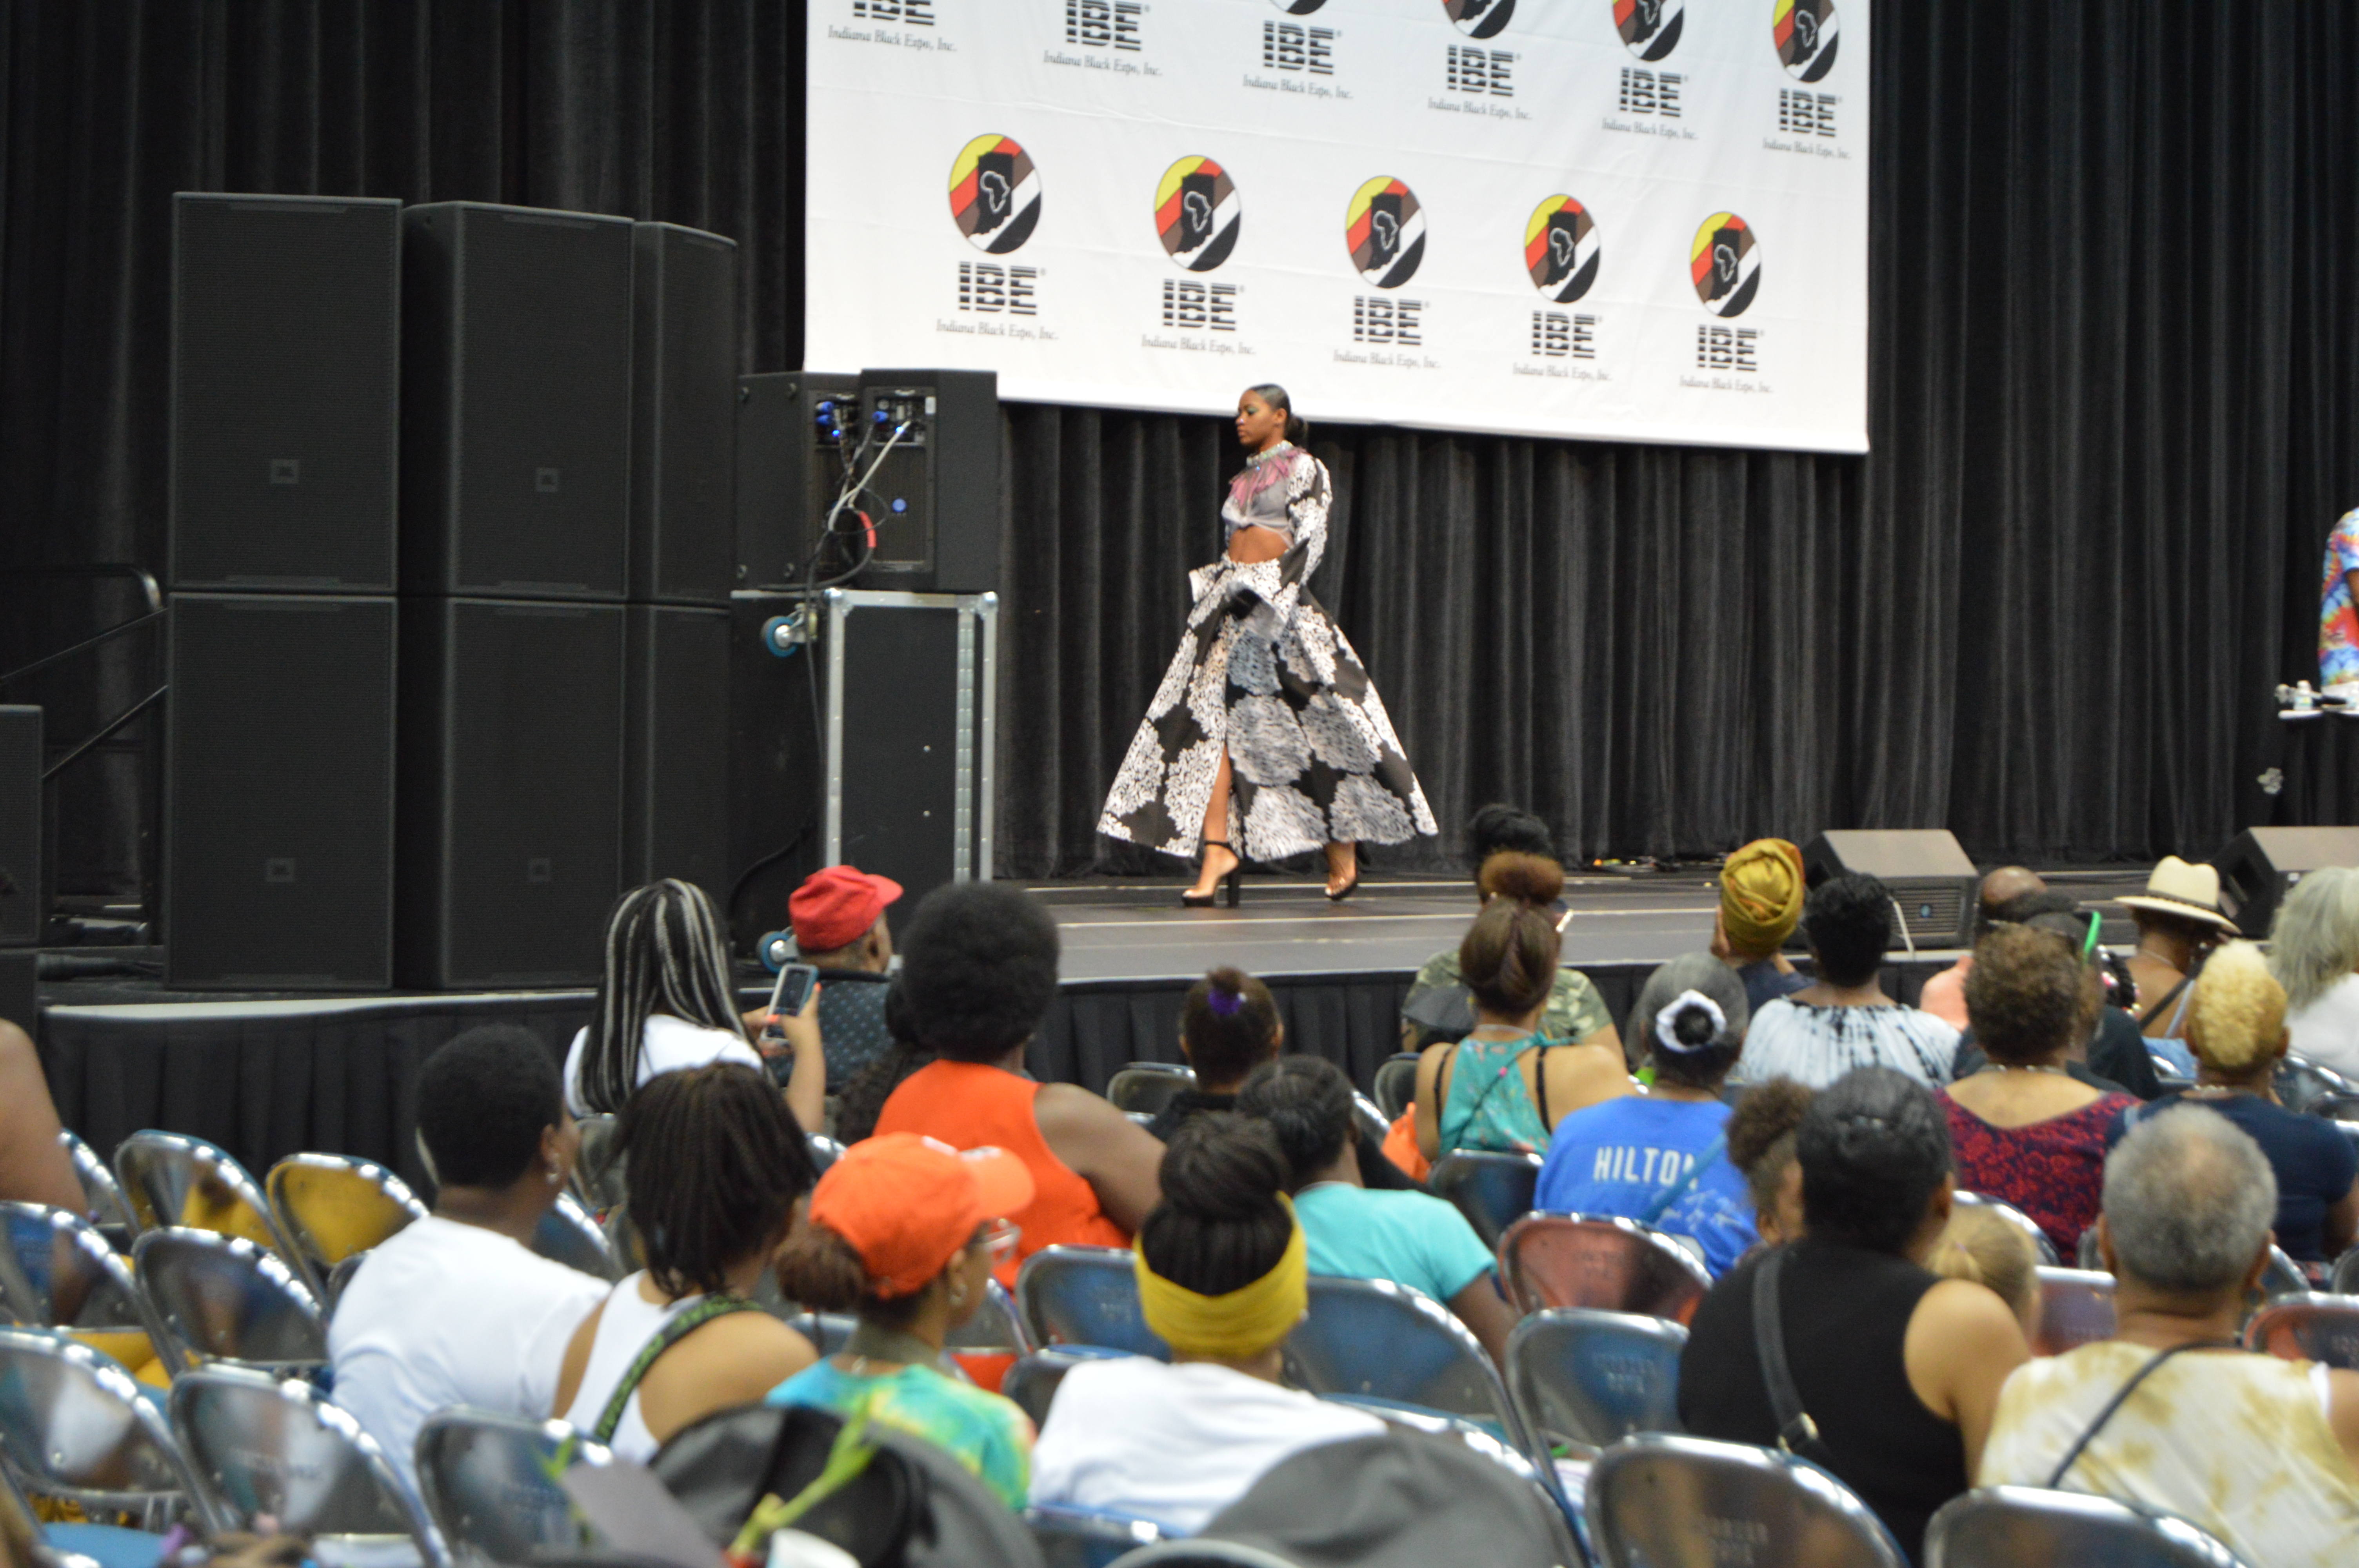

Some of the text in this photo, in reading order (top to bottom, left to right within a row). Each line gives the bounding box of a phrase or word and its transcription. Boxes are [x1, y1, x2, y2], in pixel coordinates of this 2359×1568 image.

[828, 25, 871, 42] Indiana
[874, 29, 901, 45] Black
[937, 37, 957, 51] Inc.
[1263, 21, 1334, 75] IBE
[1043, 50, 1082, 67] Indiana
[1084, 55, 1110, 70] Black
[1143, 62, 1163, 76] Inc.
[1447, 44, 1514, 97] IBE
[1243, 74, 1278, 90] Indiana
[1280, 79, 1305, 93] Black
[1336, 86, 1353, 100] Inc.
[1619, 67, 1681, 118] IBE
[1428, 97, 1461, 112] Indiana
[1463, 101, 1487, 115] Black
[1515, 108, 1532, 120] Inc.
[1779, 89, 1836, 137] IBE
[1601, 118, 1632, 132] Indiana
[1633, 122, 1657, 135] Black
[1682, 127, 1698, 140] Inc.
[1763, 138, 1792, 152] Indiana
[1794, 142, 1814, 154] Black
[1837, 148, 1851, 160] Inc.
[959, 262, 1037, 316] IBE
[1163, 279, 1236, 331] IBE
[936, 319, 975, 334] Indiana
[978, 322, 1005, 336] Black
[1039, 327, 1058, 340] Inc.
[1354, 296, 1422, 346] IBE
[1141, 334, 1178, 349] Indiana
[1180, 337, 1206, 351] Black
[1238, 342, 1256, 355] Inc.
[1532, 311, 1595, 359] IBE
[1334, 350, 1367, 363] Indiana
[1370, 352, 1394, 365] Black
[1424, 356, 1441, 369] Inc.
[1697, 325, 1757, 372] IBE
[1513, 363, 1544, 376] Indiana
[1546, 365, 1569, 377] Black
[1596, 370, 1612, 381] Inc.
[1679, 376, 1710, 388] Indiana
[1712, 378, 1732, 390] Black
[1758, 382, 1774, 394] Inc.
